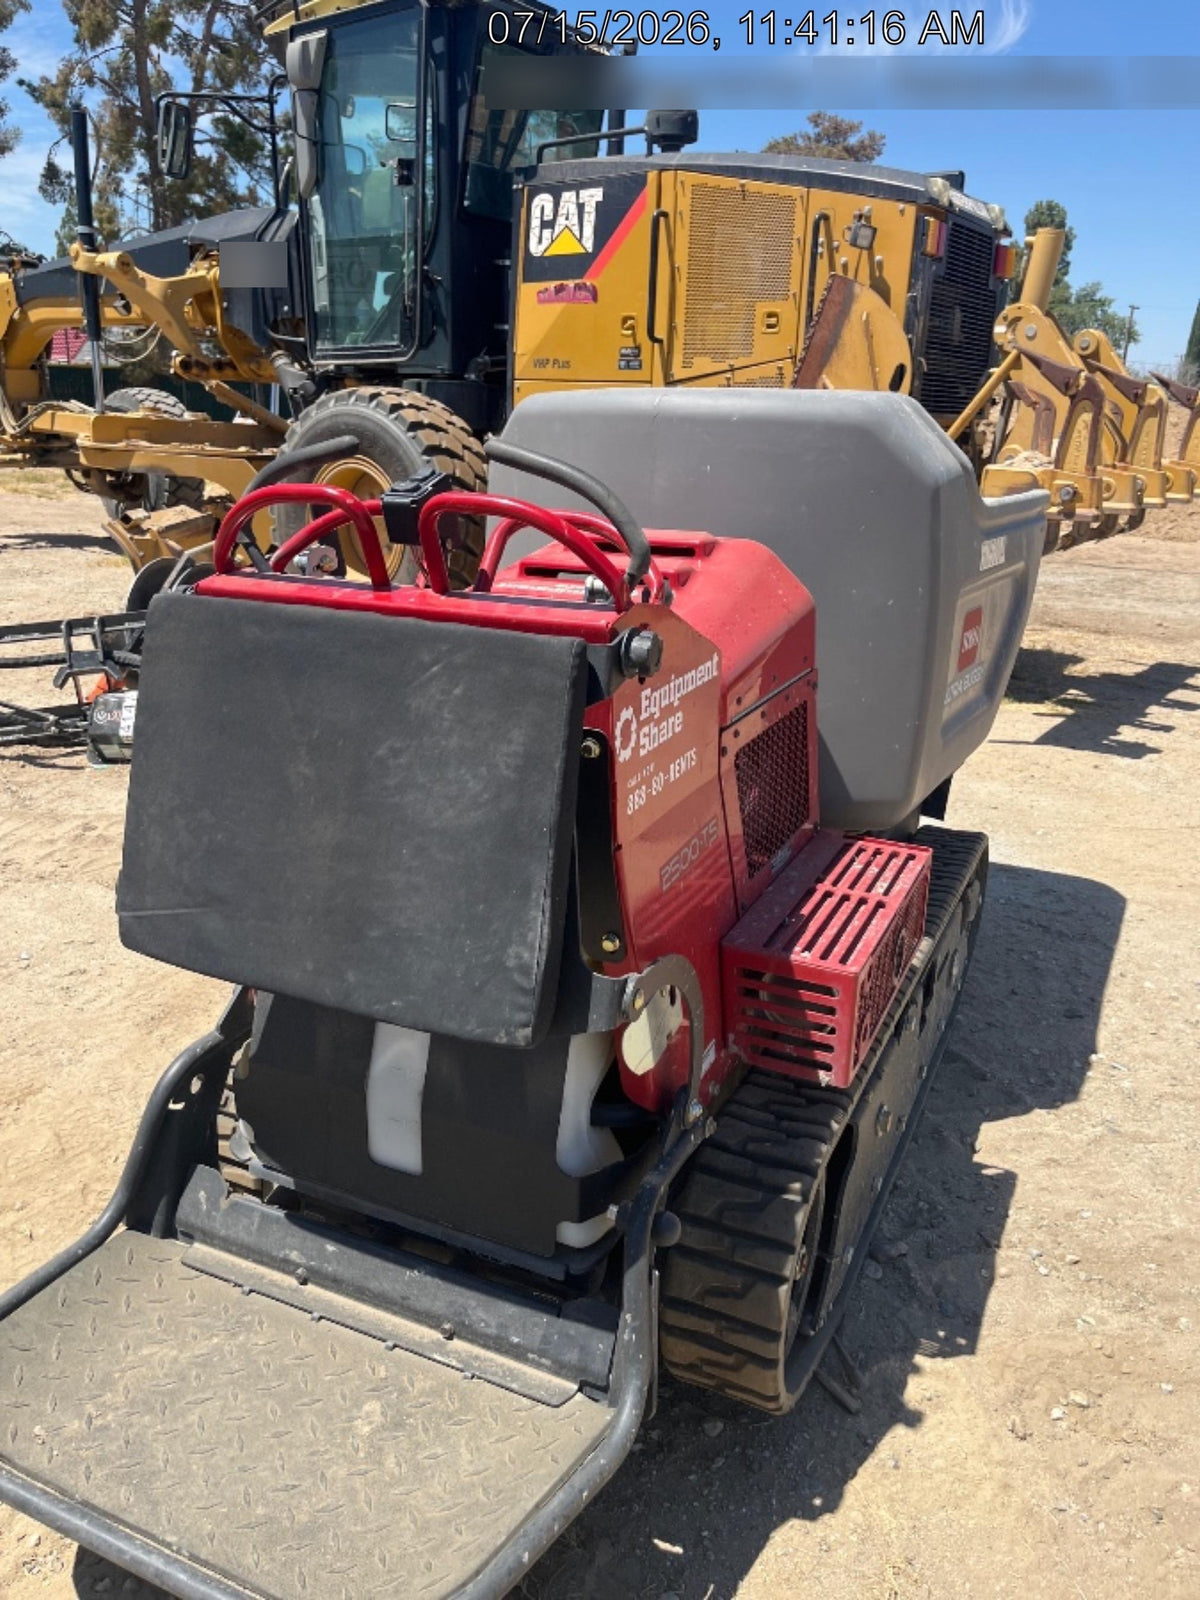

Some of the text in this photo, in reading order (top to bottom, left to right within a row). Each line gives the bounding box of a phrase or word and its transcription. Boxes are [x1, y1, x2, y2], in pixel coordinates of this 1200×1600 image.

[529, 187, 604, 257] CAT
[640, 652, 719, 720] Equipment
[639, 710, 683, 757] Share
